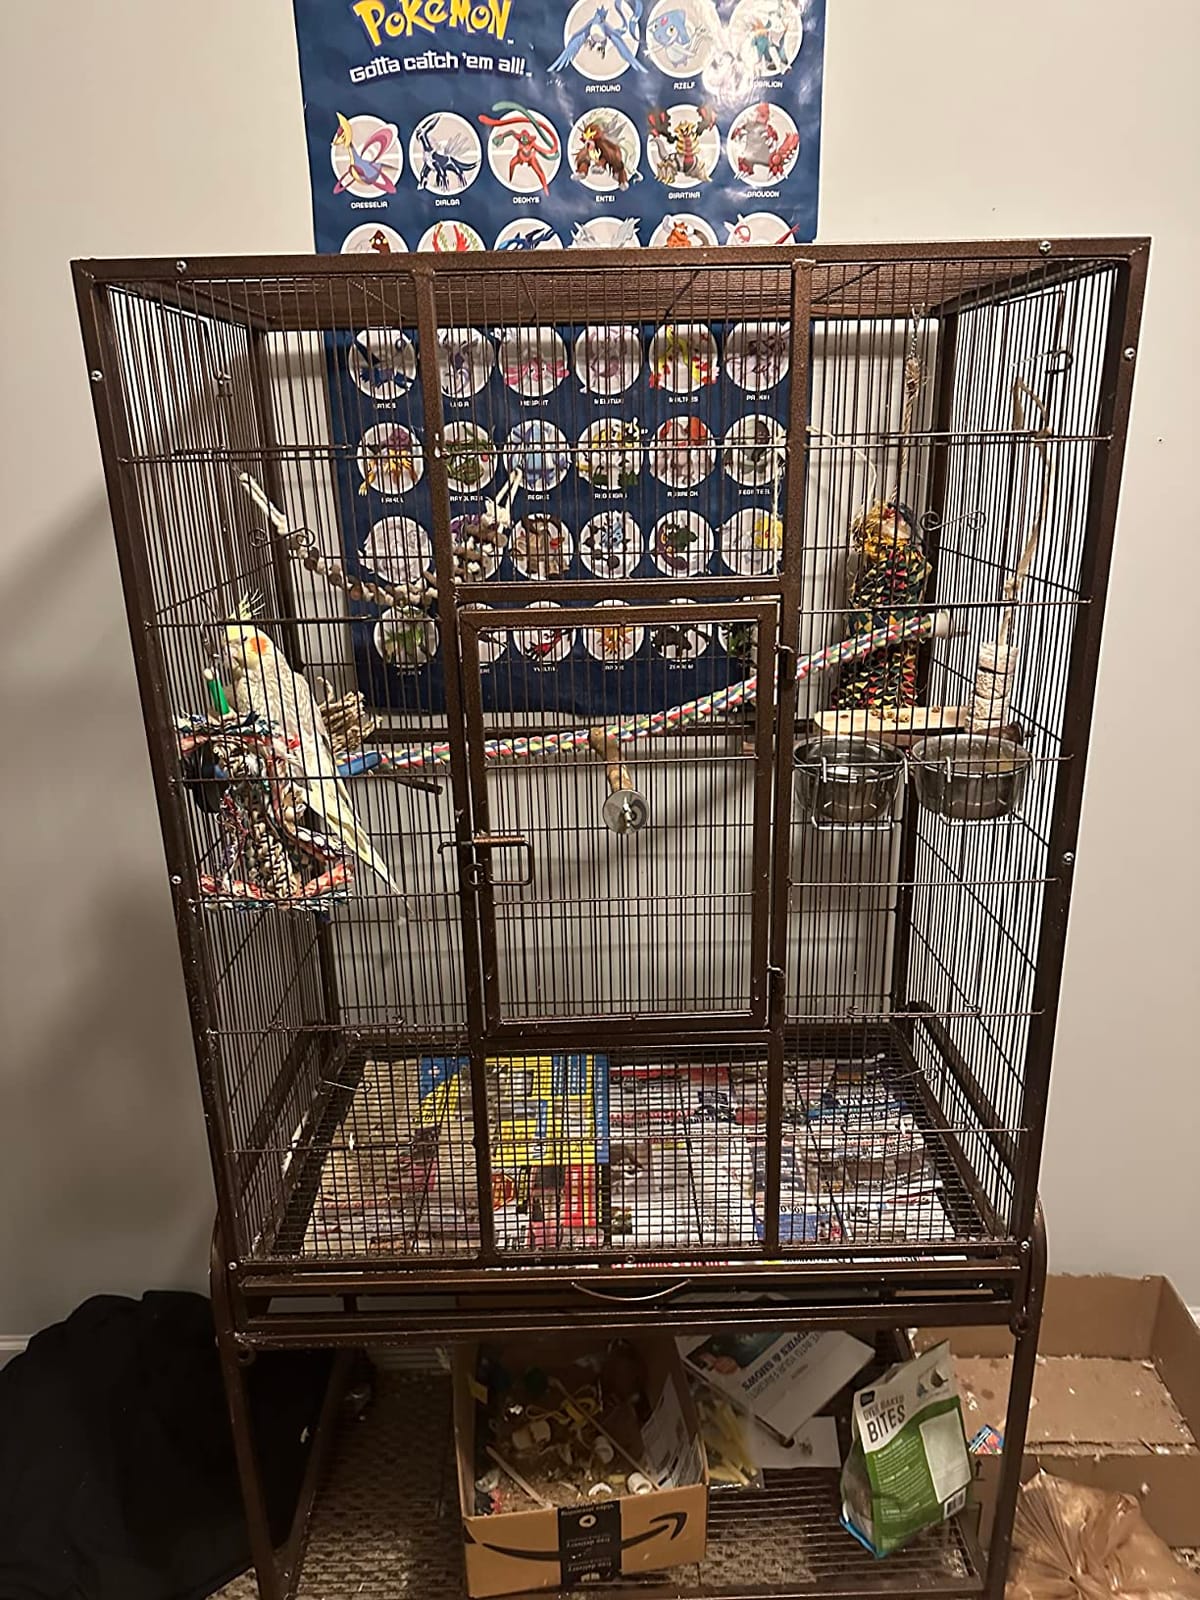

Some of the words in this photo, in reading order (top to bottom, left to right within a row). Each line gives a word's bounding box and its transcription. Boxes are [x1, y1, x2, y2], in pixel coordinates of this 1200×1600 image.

[350, 56, 400, 83] Gotta
[403, 50, 458, 70] catch
[498, 57, 526, 76] all!
[751, 80, 783, 89] OBALION
[435, 198, 460, 207] DIALGA
[865, 1404, 906, 1444] BITES
